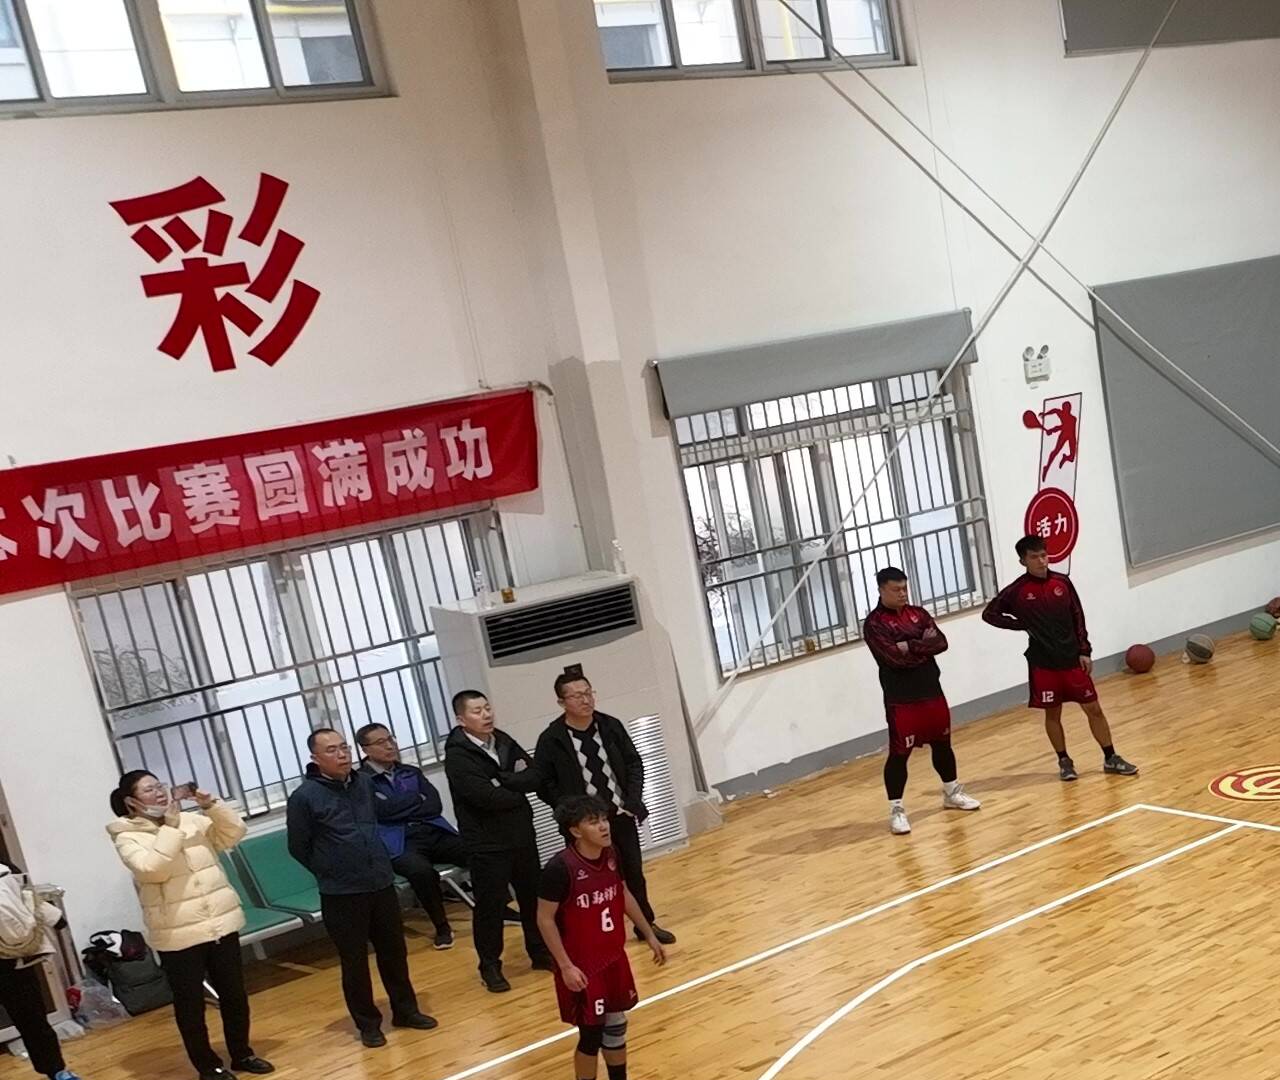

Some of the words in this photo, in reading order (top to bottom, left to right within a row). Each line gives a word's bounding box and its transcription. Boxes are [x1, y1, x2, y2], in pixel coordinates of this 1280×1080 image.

[109, 172, 321, 372] 彩
[1036, 513, 1068, 538] 活力
[1041, 690, 1055, 703] 12
[600, 906, 615, 932] 6
[594, 998, 605, 1016] 6
